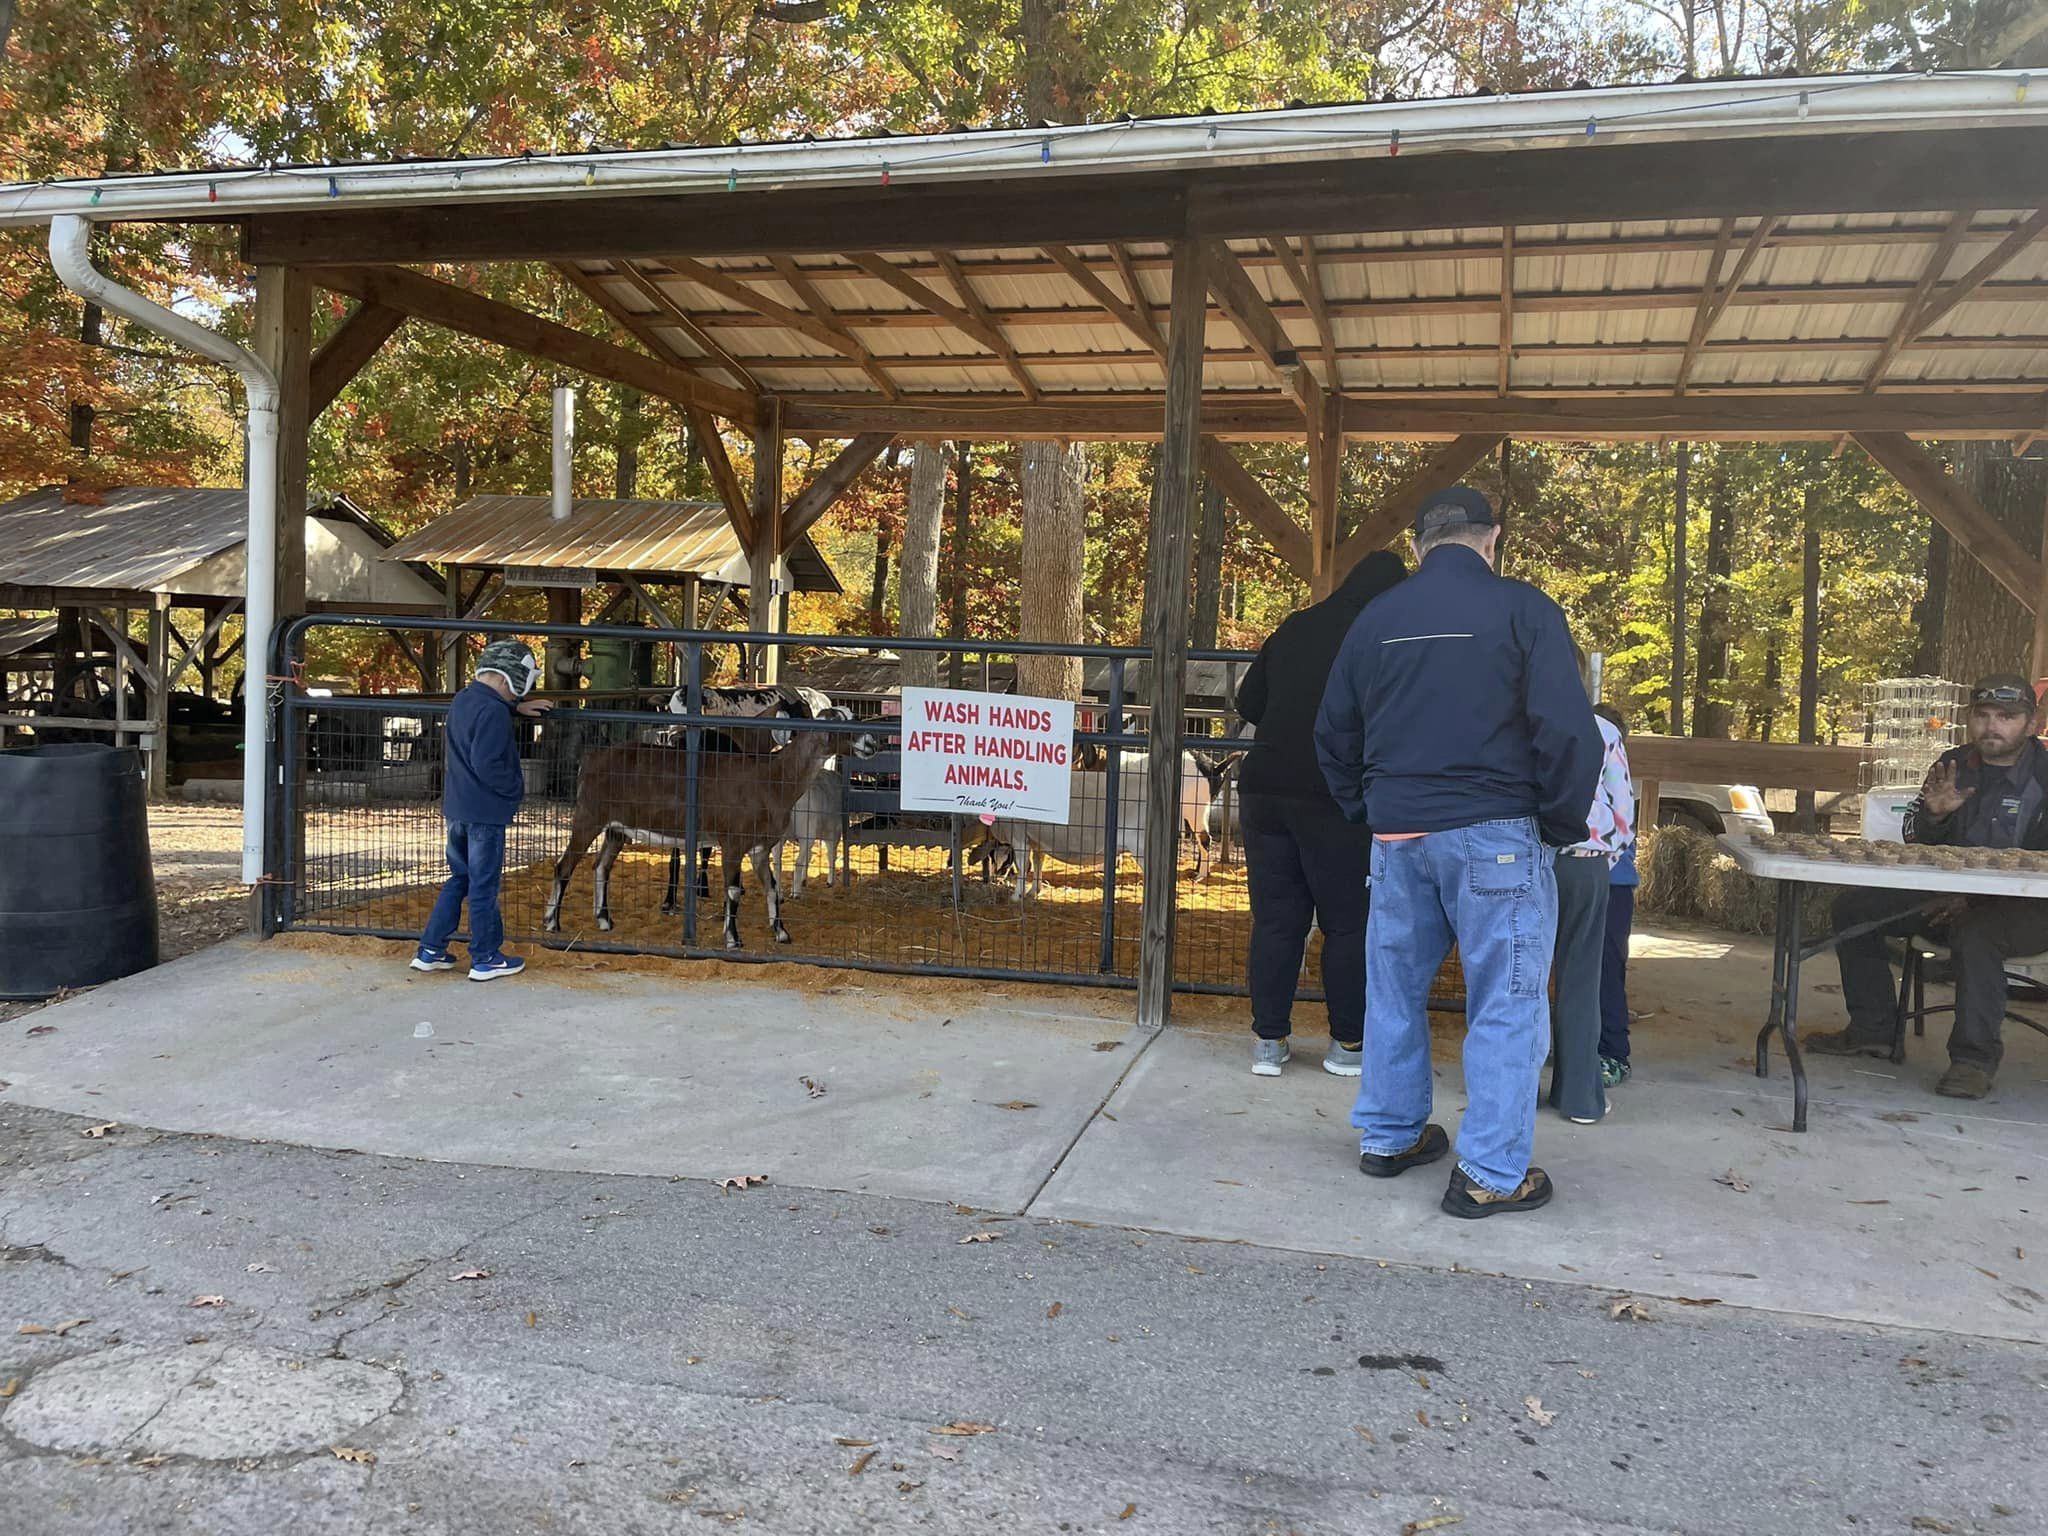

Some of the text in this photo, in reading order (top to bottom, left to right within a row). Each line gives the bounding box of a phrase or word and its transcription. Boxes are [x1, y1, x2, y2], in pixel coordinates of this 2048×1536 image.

[924, 700, 1051, 732] WASH HANDS
[908, 731, 1067, 765] AFTER HANDLING
[944, 764, 1028, 791] ANIMALS.
[956, 795, 1015, 811] Thank You!
